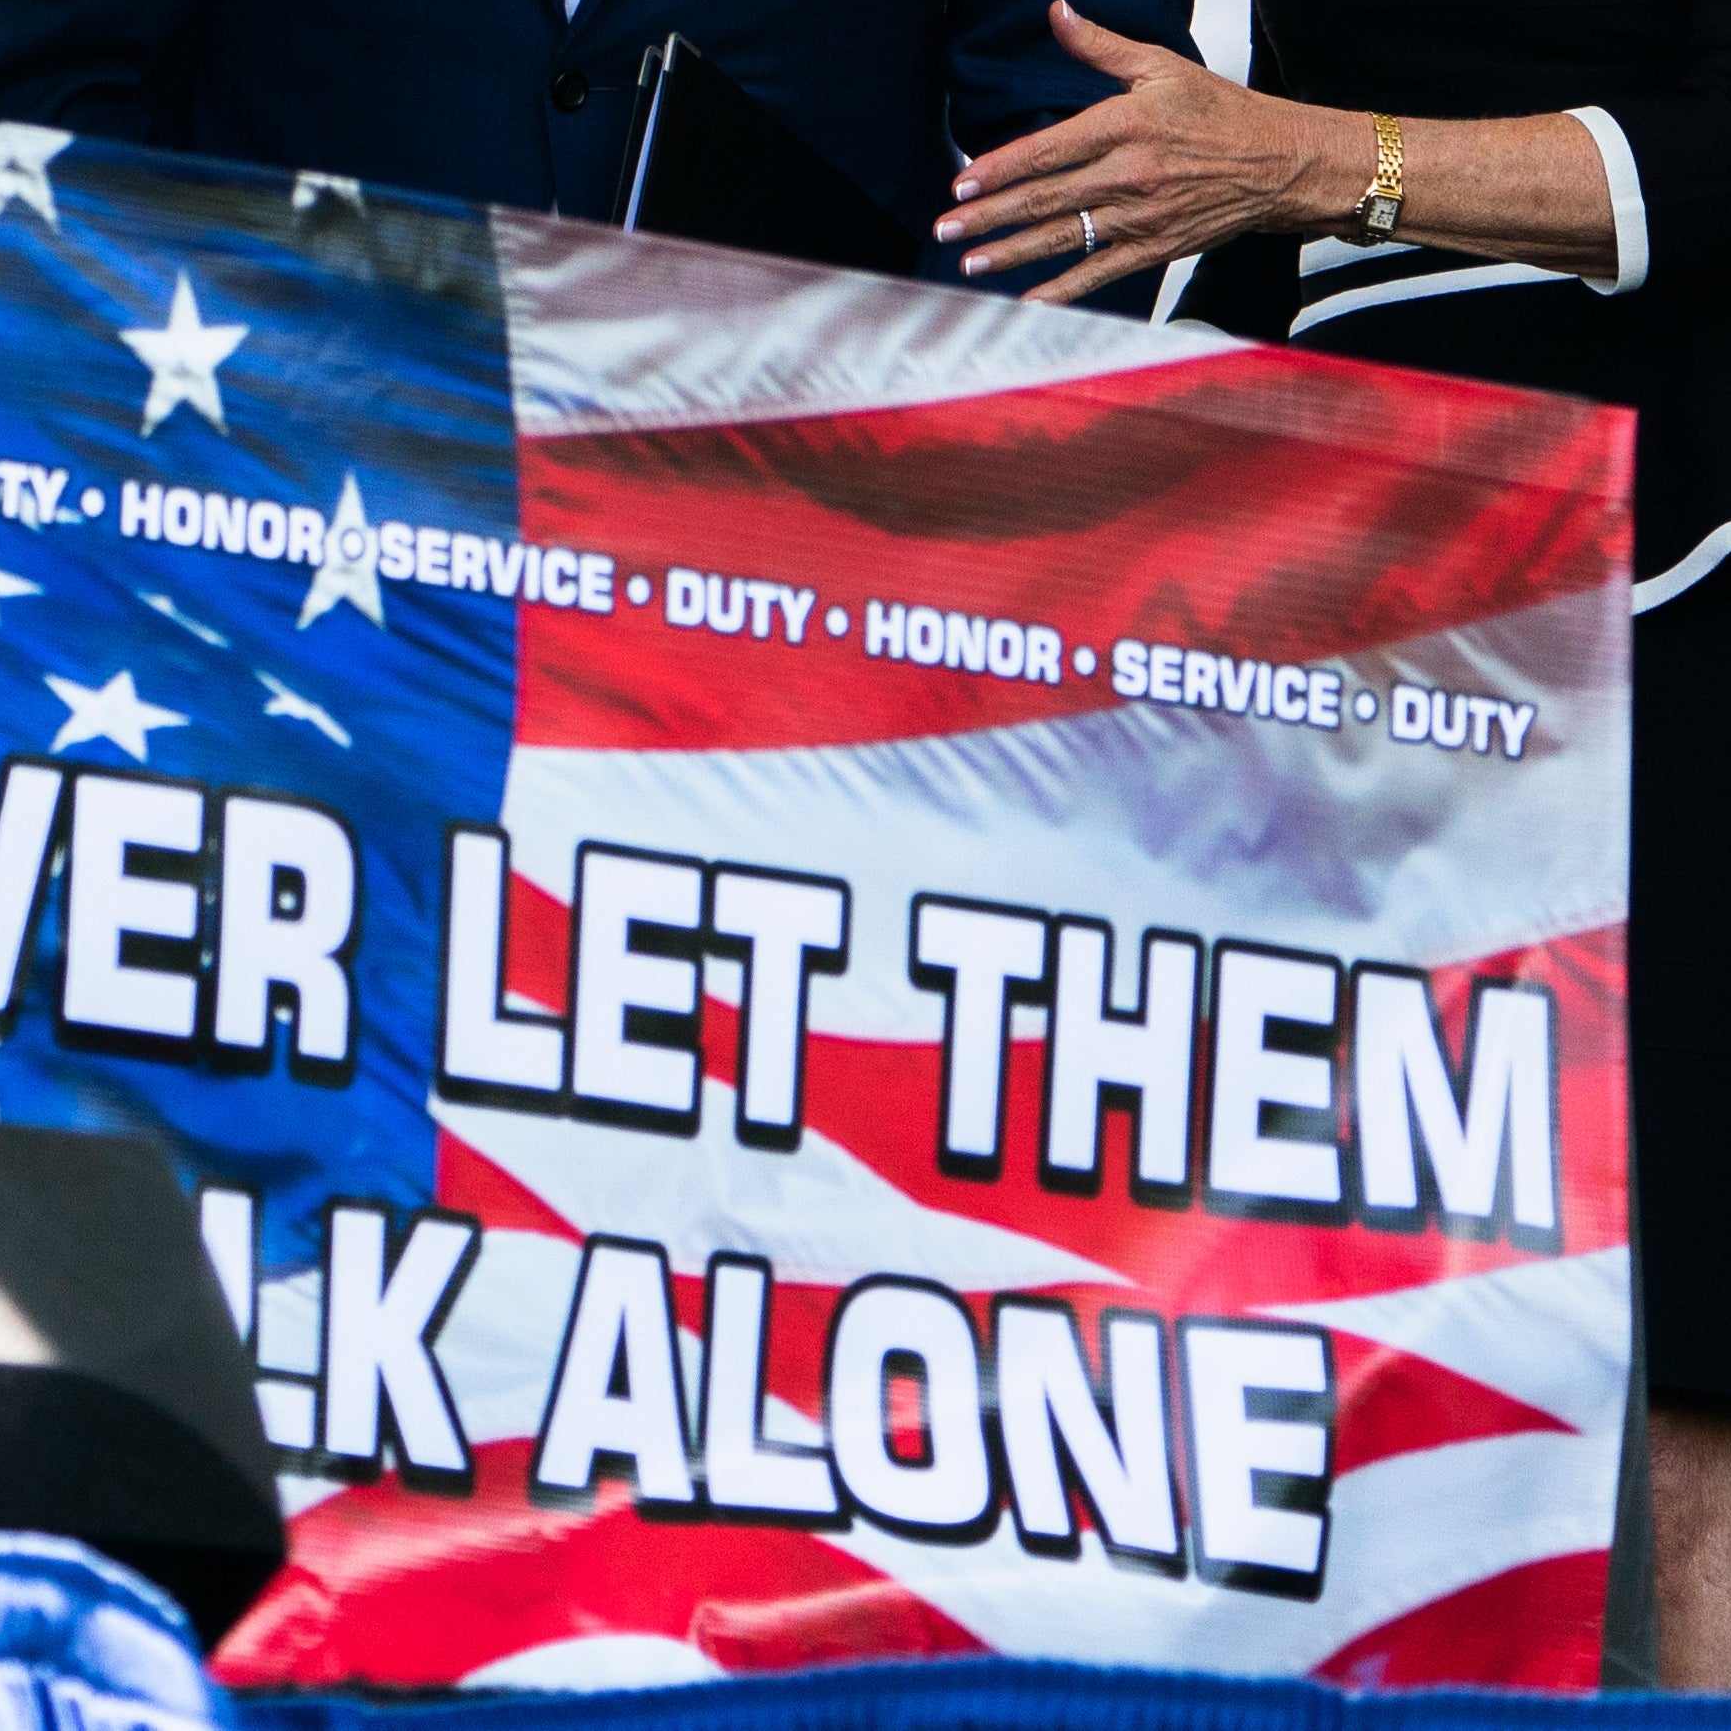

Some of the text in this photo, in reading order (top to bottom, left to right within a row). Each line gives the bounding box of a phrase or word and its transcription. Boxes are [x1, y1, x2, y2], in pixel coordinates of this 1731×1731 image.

[119, 481, 323, 565] HONOR
[376, 521, 614, 614] SERVICE
[664, 568, 816, 645] DUTY
[864, 600, 1063, 685] HONOR
[1111, 639, 1342, 729] SERVICE
[1389, 692, 1538, 759] DUTY
[441, 825, 849, 1133] LET
[911, 897, 1559, 1235] THEM
[531, 1235, 1333, 1581] ALONE
